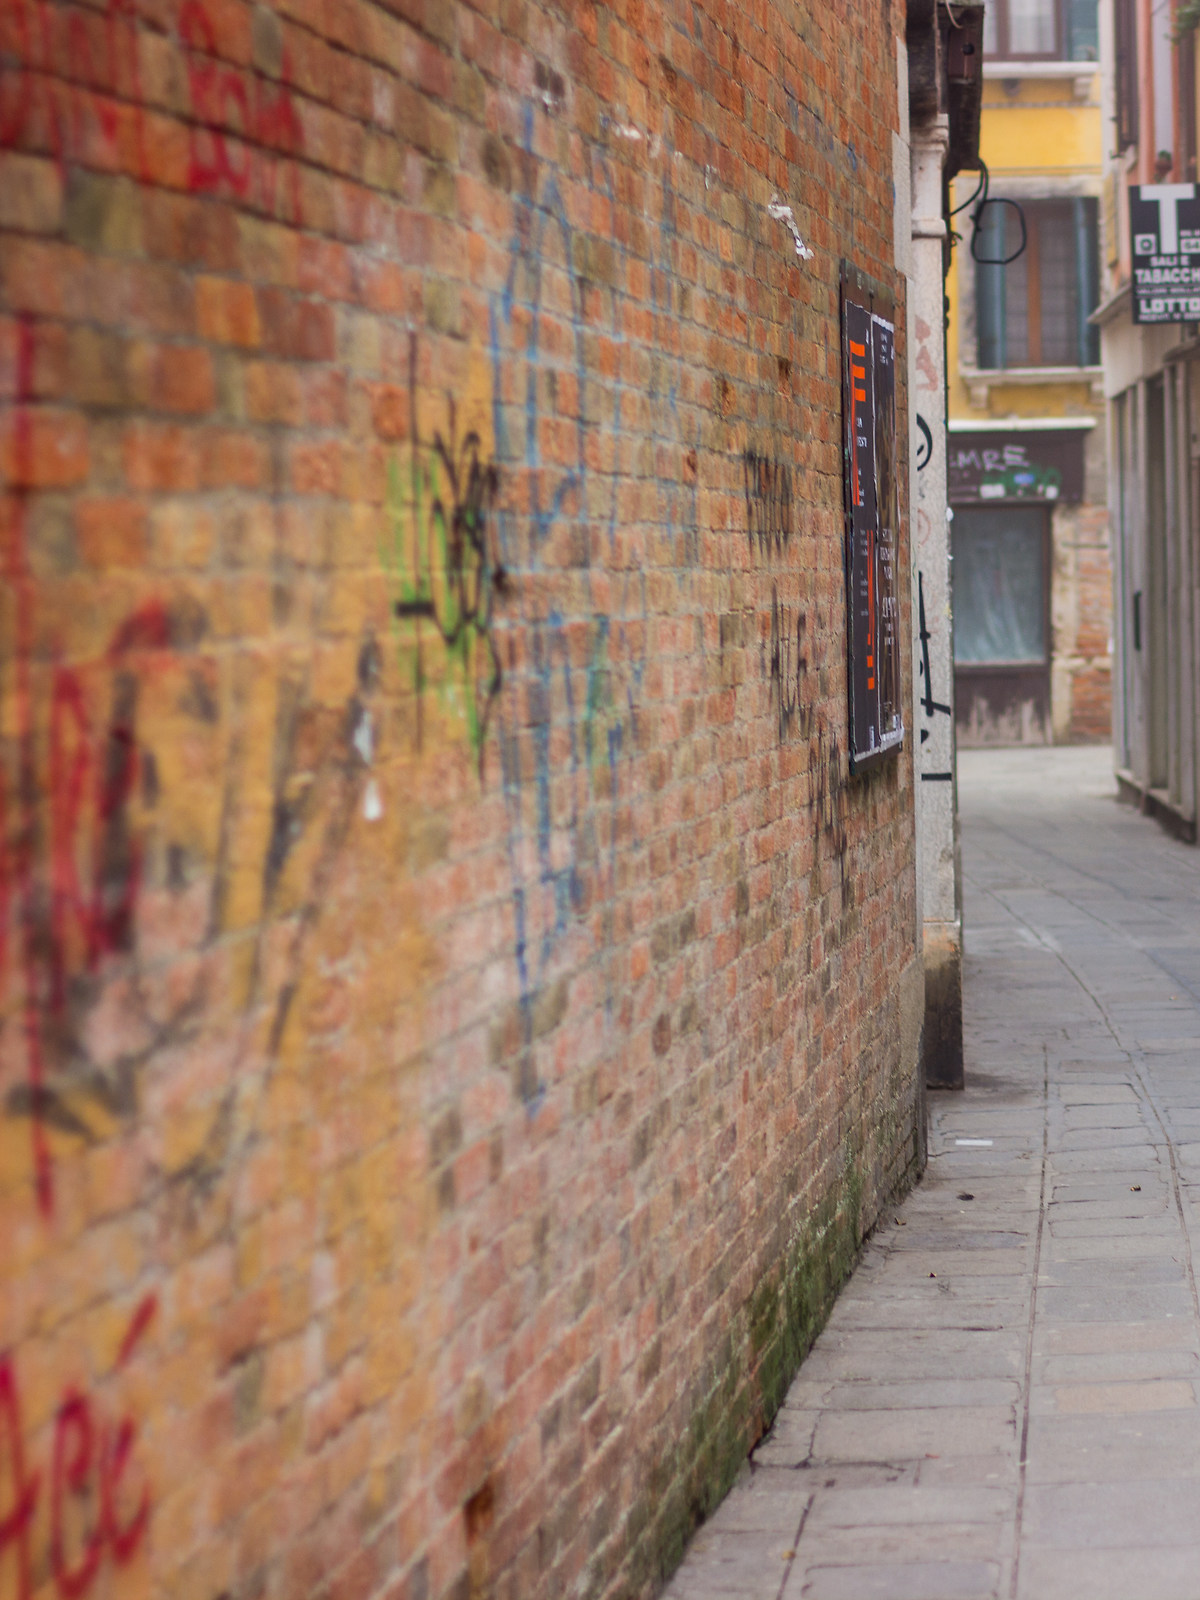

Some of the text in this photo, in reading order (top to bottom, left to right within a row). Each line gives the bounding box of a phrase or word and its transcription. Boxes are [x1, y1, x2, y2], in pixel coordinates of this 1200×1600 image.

[1139, 184, 1195, 254] T
[1150, 255, 1189, 266] SALI E
